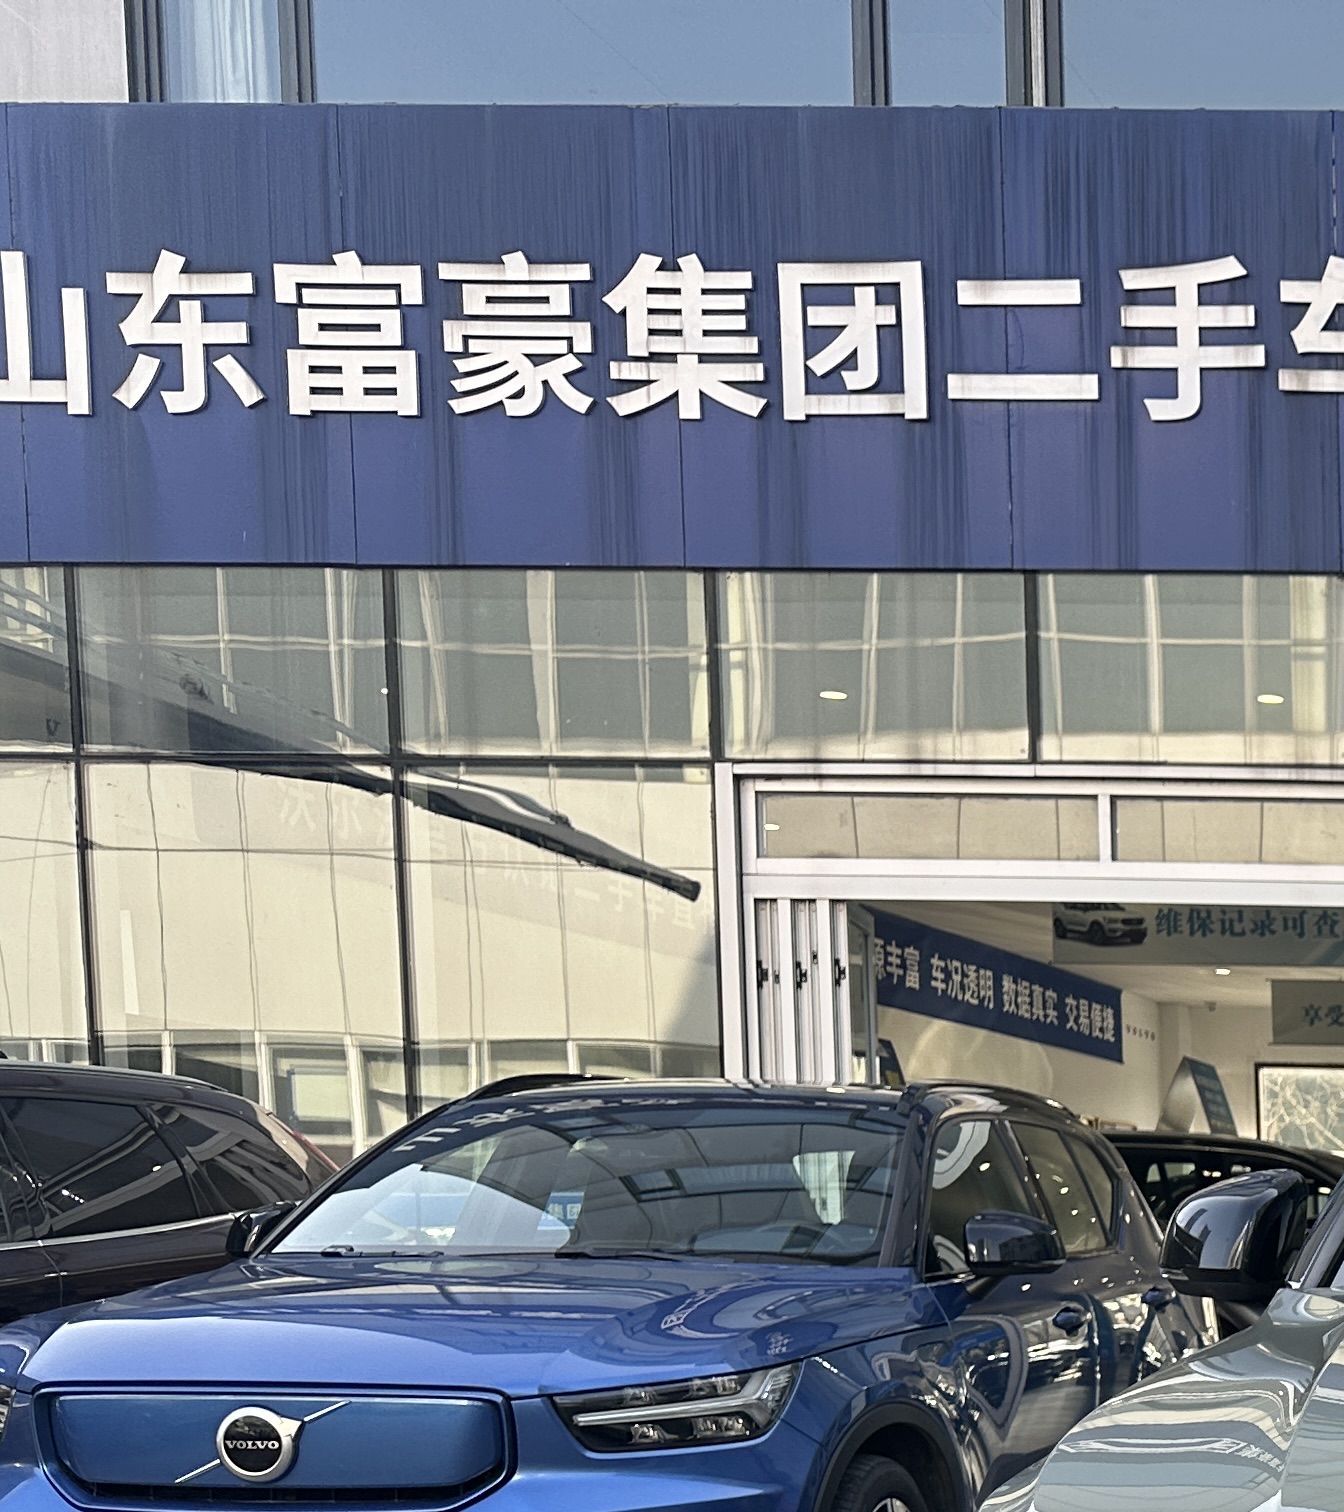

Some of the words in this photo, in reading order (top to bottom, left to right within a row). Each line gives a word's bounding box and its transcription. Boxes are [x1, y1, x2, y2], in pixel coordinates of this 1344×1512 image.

[1154, 907, 1342, 940] 维保记录可查
[930, 953, 995, 1010] 车况透明
[1002, 973, 1059, 1026] 数据真实
[224, 1439, 280, 1450] VOLVO
